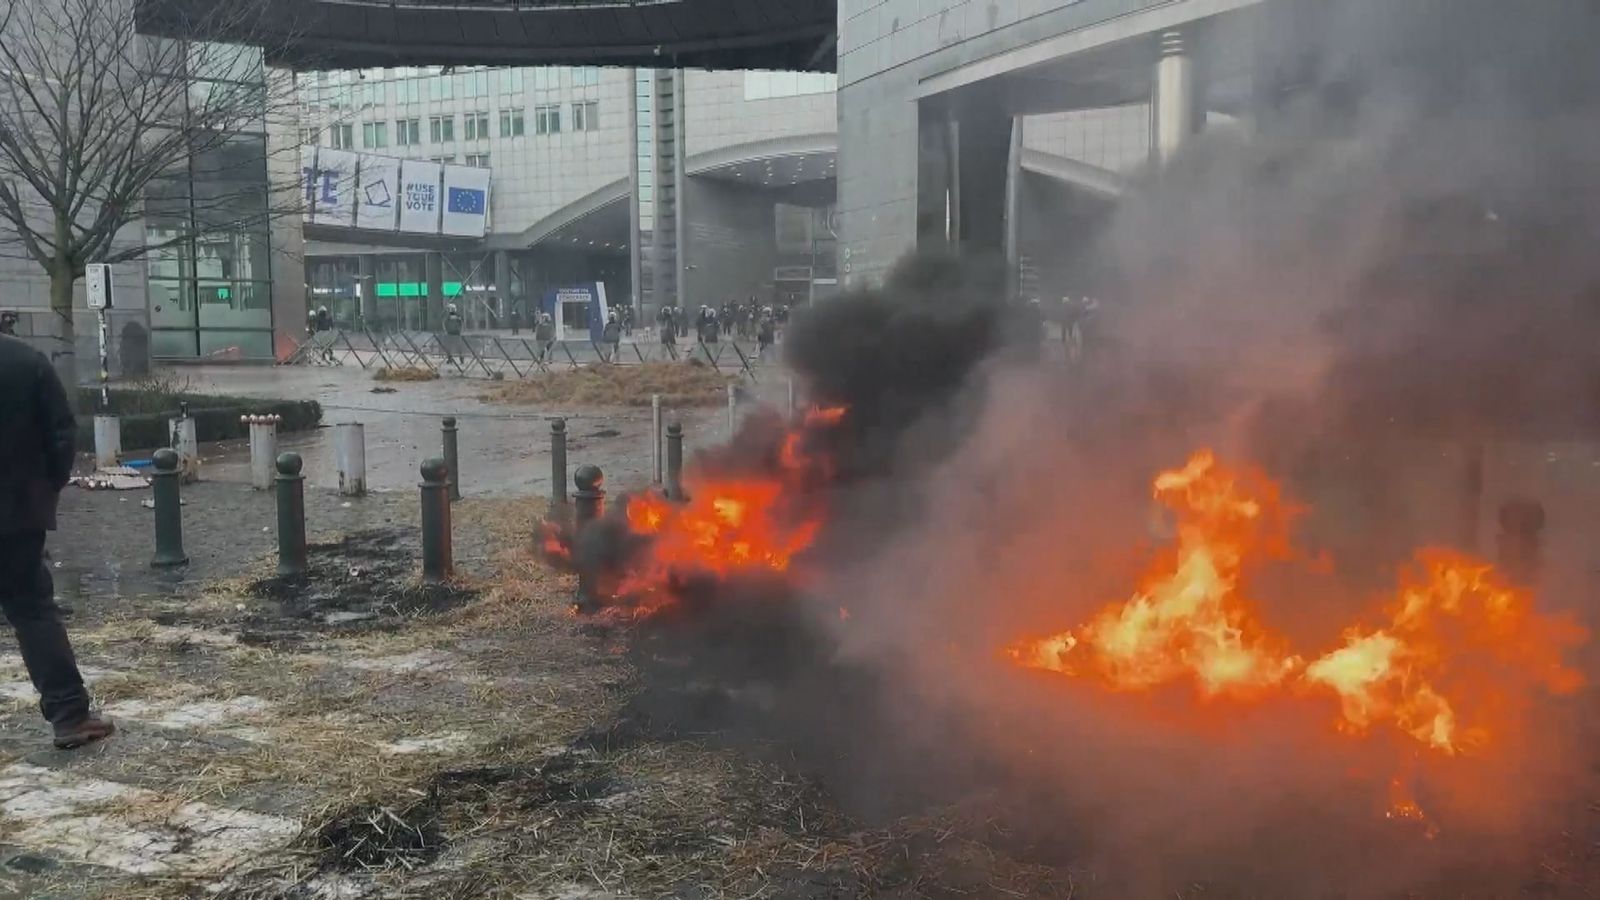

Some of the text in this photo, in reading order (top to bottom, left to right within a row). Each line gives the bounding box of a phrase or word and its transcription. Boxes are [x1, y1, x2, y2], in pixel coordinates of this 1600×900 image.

[406, 183, 435, 194] #USE
[406, 193, 435, 202] YOUR
[406, 202, 435, 211] VOTE
